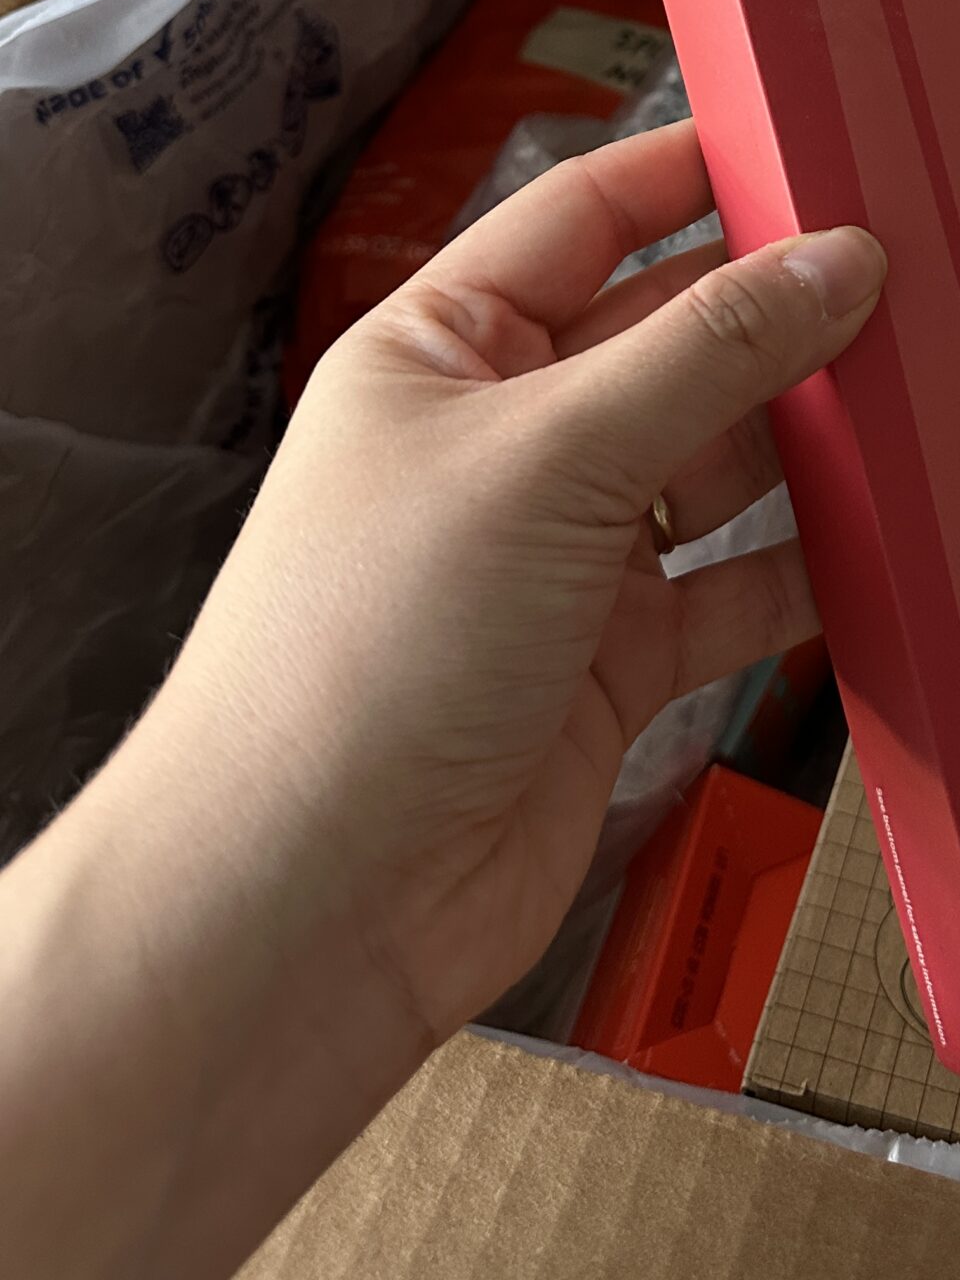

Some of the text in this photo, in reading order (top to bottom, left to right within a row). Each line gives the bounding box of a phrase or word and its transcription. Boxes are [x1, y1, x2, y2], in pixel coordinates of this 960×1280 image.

[876, 788, 886, 813] See
[883, 815, 898, 863] bottom
[895, 865, 910, 902] panel
[906, 904, 914, 924] for
[912, 925, 925, 966] safety
